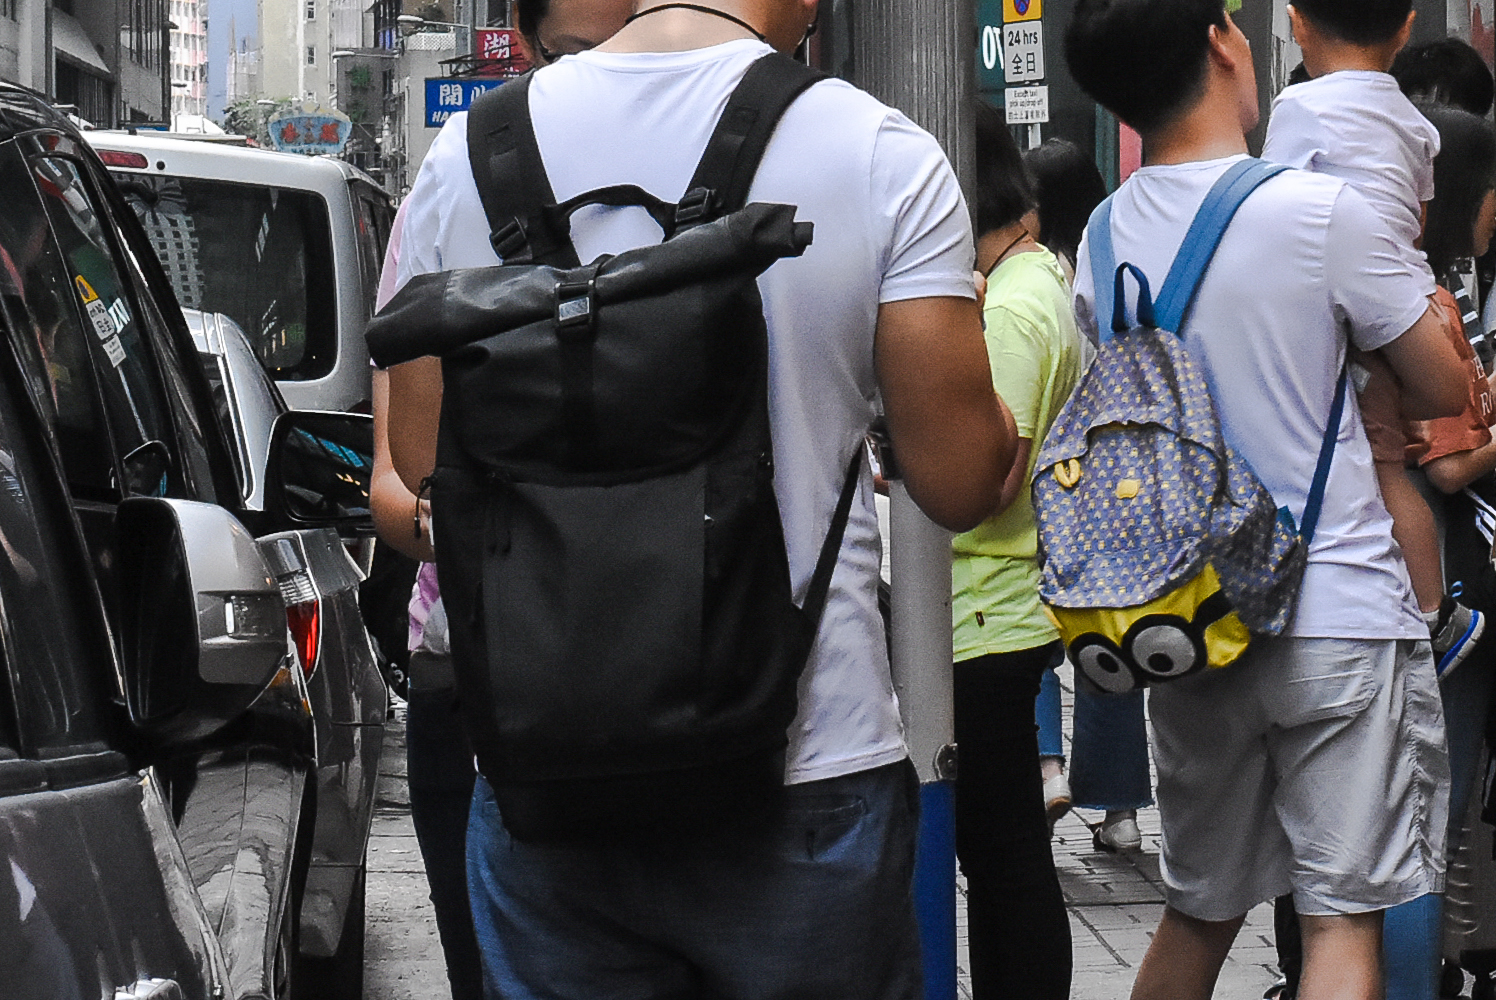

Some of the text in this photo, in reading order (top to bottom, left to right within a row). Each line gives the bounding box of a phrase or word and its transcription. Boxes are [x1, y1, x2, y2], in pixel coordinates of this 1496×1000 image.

[1008, 29, 1038, 46] 24 hrs
[1012, 52, 1036, 75] 全日
